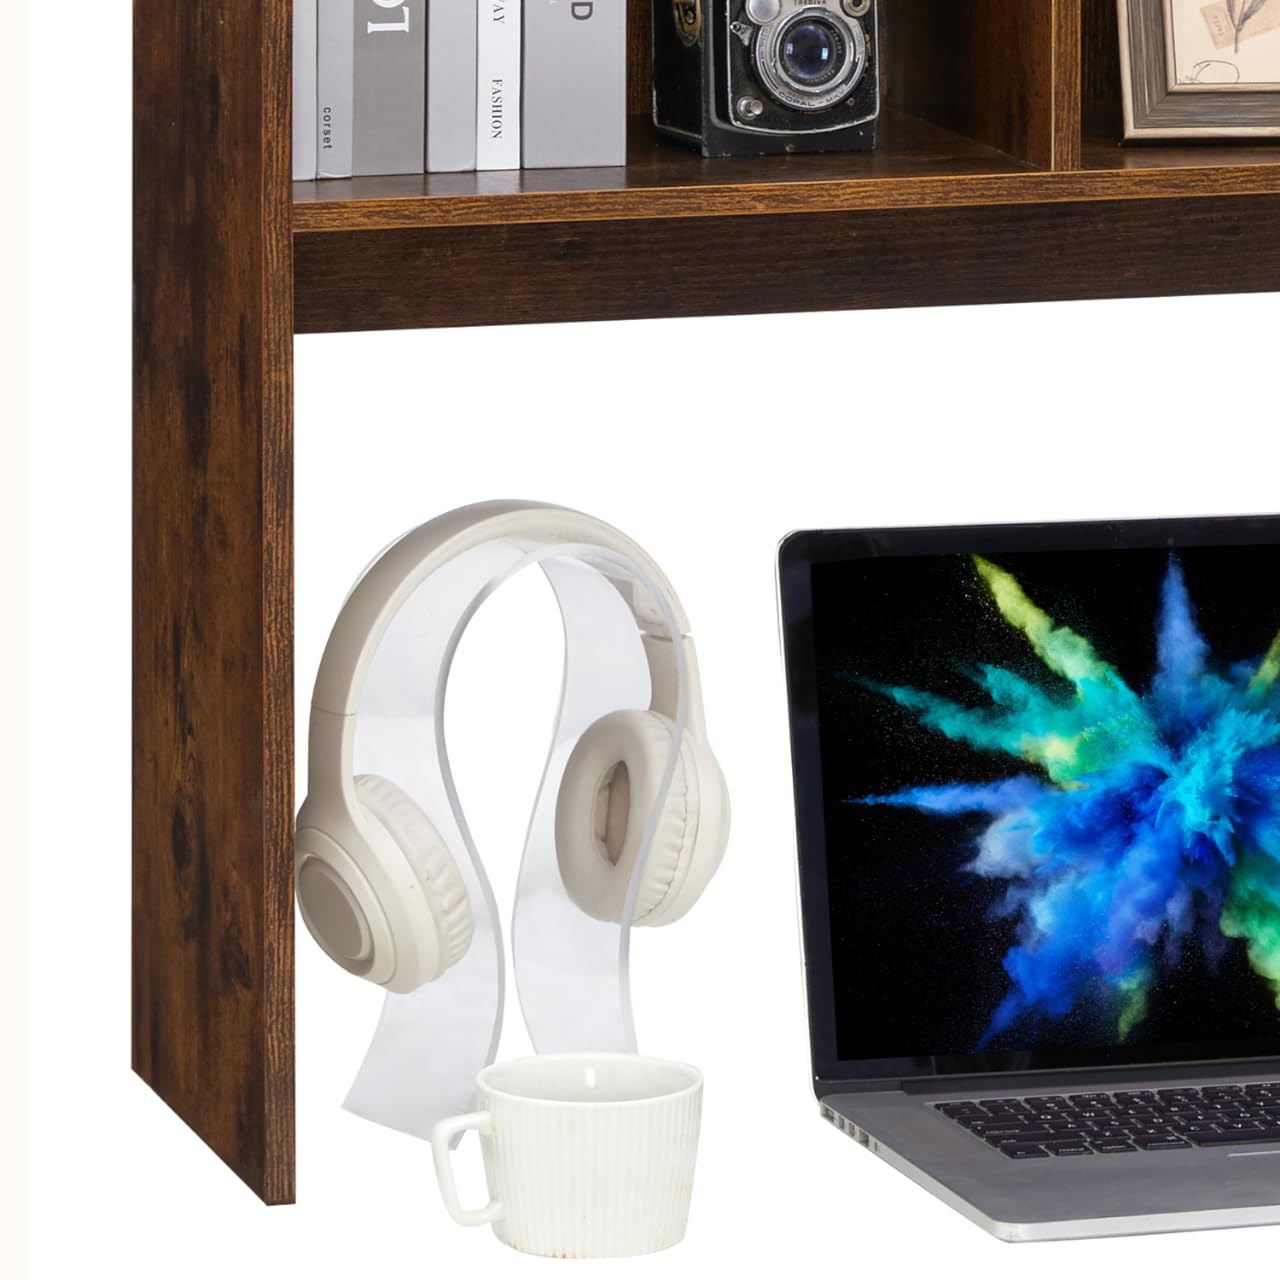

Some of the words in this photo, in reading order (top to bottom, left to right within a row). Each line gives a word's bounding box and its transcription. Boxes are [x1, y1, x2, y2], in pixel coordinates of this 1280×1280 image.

[492, 79, 503, 139] FASHION
[778, 91, 816, 107] COPAL
[322, 107, 332, 149] corset
